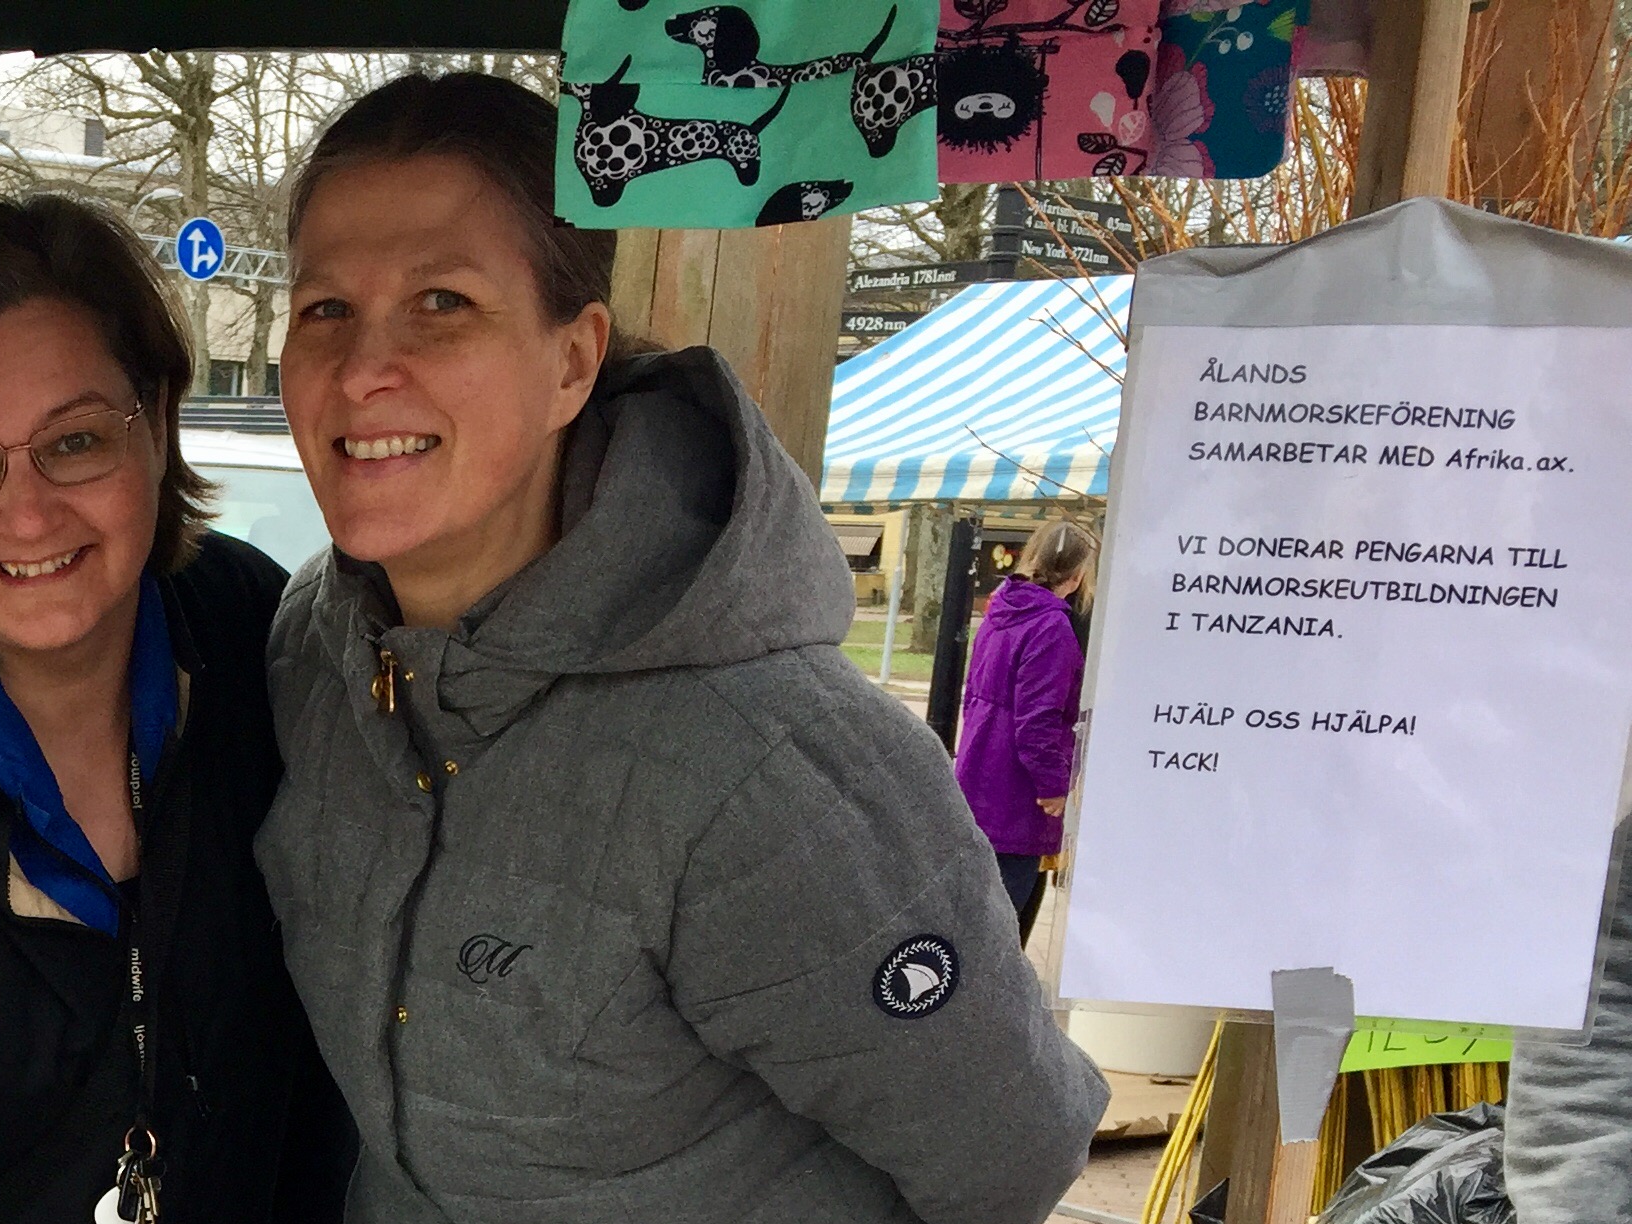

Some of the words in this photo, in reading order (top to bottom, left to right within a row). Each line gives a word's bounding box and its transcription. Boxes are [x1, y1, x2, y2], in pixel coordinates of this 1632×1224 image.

[1021, 239, 1044, 256] New
[1045, 242, 1068, 259] York
[855, 272, 910, 289] Alexandria
[912, 268, 957, 285] 1781nm
[845, 316, 907, 331] 4928nm
[1198, 356, 1308, 384] ÅLANDS
[1193, 400, 1516, 430] BARNMORSKEFÖRENING
[1188, 441, 1368, 465] SAMARBETAR
[1378, 445, 1435, 467] MED
[1445, 448, 1575, 473] Afrika.ax.
[1177, 534, 1208, 556] VI
[1218, 536, 1344, 560] DONERAR
[1354, 540, 1495, 566] PENGARNA
[1508, 546, 1568, 569] TILL
[1171, 573, 1558, 608] BARNMORSKEUTBILDNINGEN
[1165, 612, 1180, 631] I
[1191, 613, 1343, 639] TANZANIA.
[1153, 702, 1235, 727] HJÄLP
[1245, 709, 1301, 730] OSS
[1311, 709, 1417, 736] HJÄLPA!
[1148, 750, 1219, 772] TACK!
[131, 947, 144, 1002] midwife
